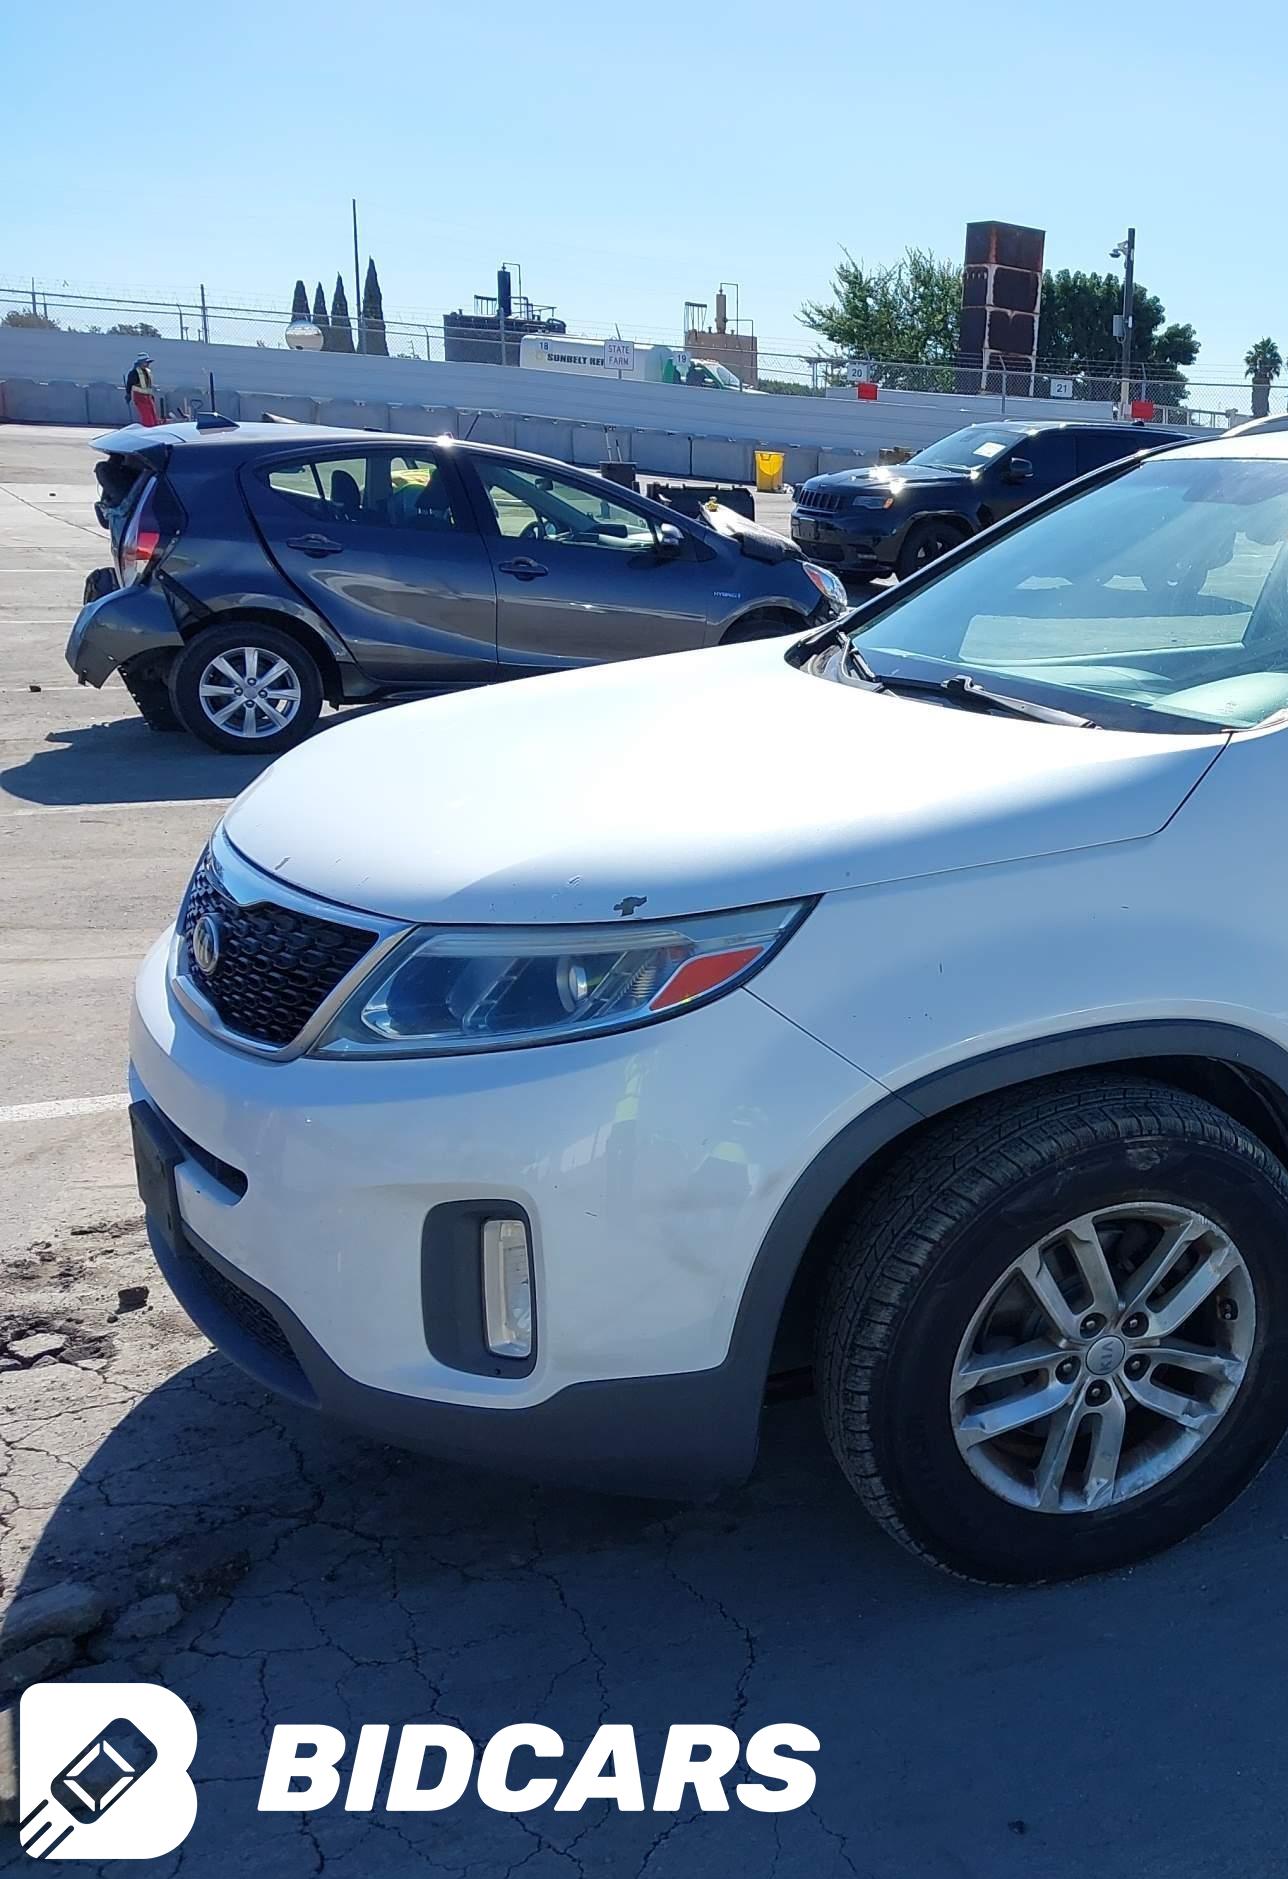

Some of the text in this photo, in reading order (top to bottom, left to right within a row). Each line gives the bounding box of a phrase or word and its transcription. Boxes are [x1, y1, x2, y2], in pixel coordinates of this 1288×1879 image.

[540, 342, 549, 350] 18
[608, 344, 629, 354] STATE
[547, 353, 588, 365] SUNBELT
[608, 356, 629, 365] FARM
[677, 354, 687, 363] 19
[851, 368, 863, 378] 20
[1056, 383, 1067, 393] 21
